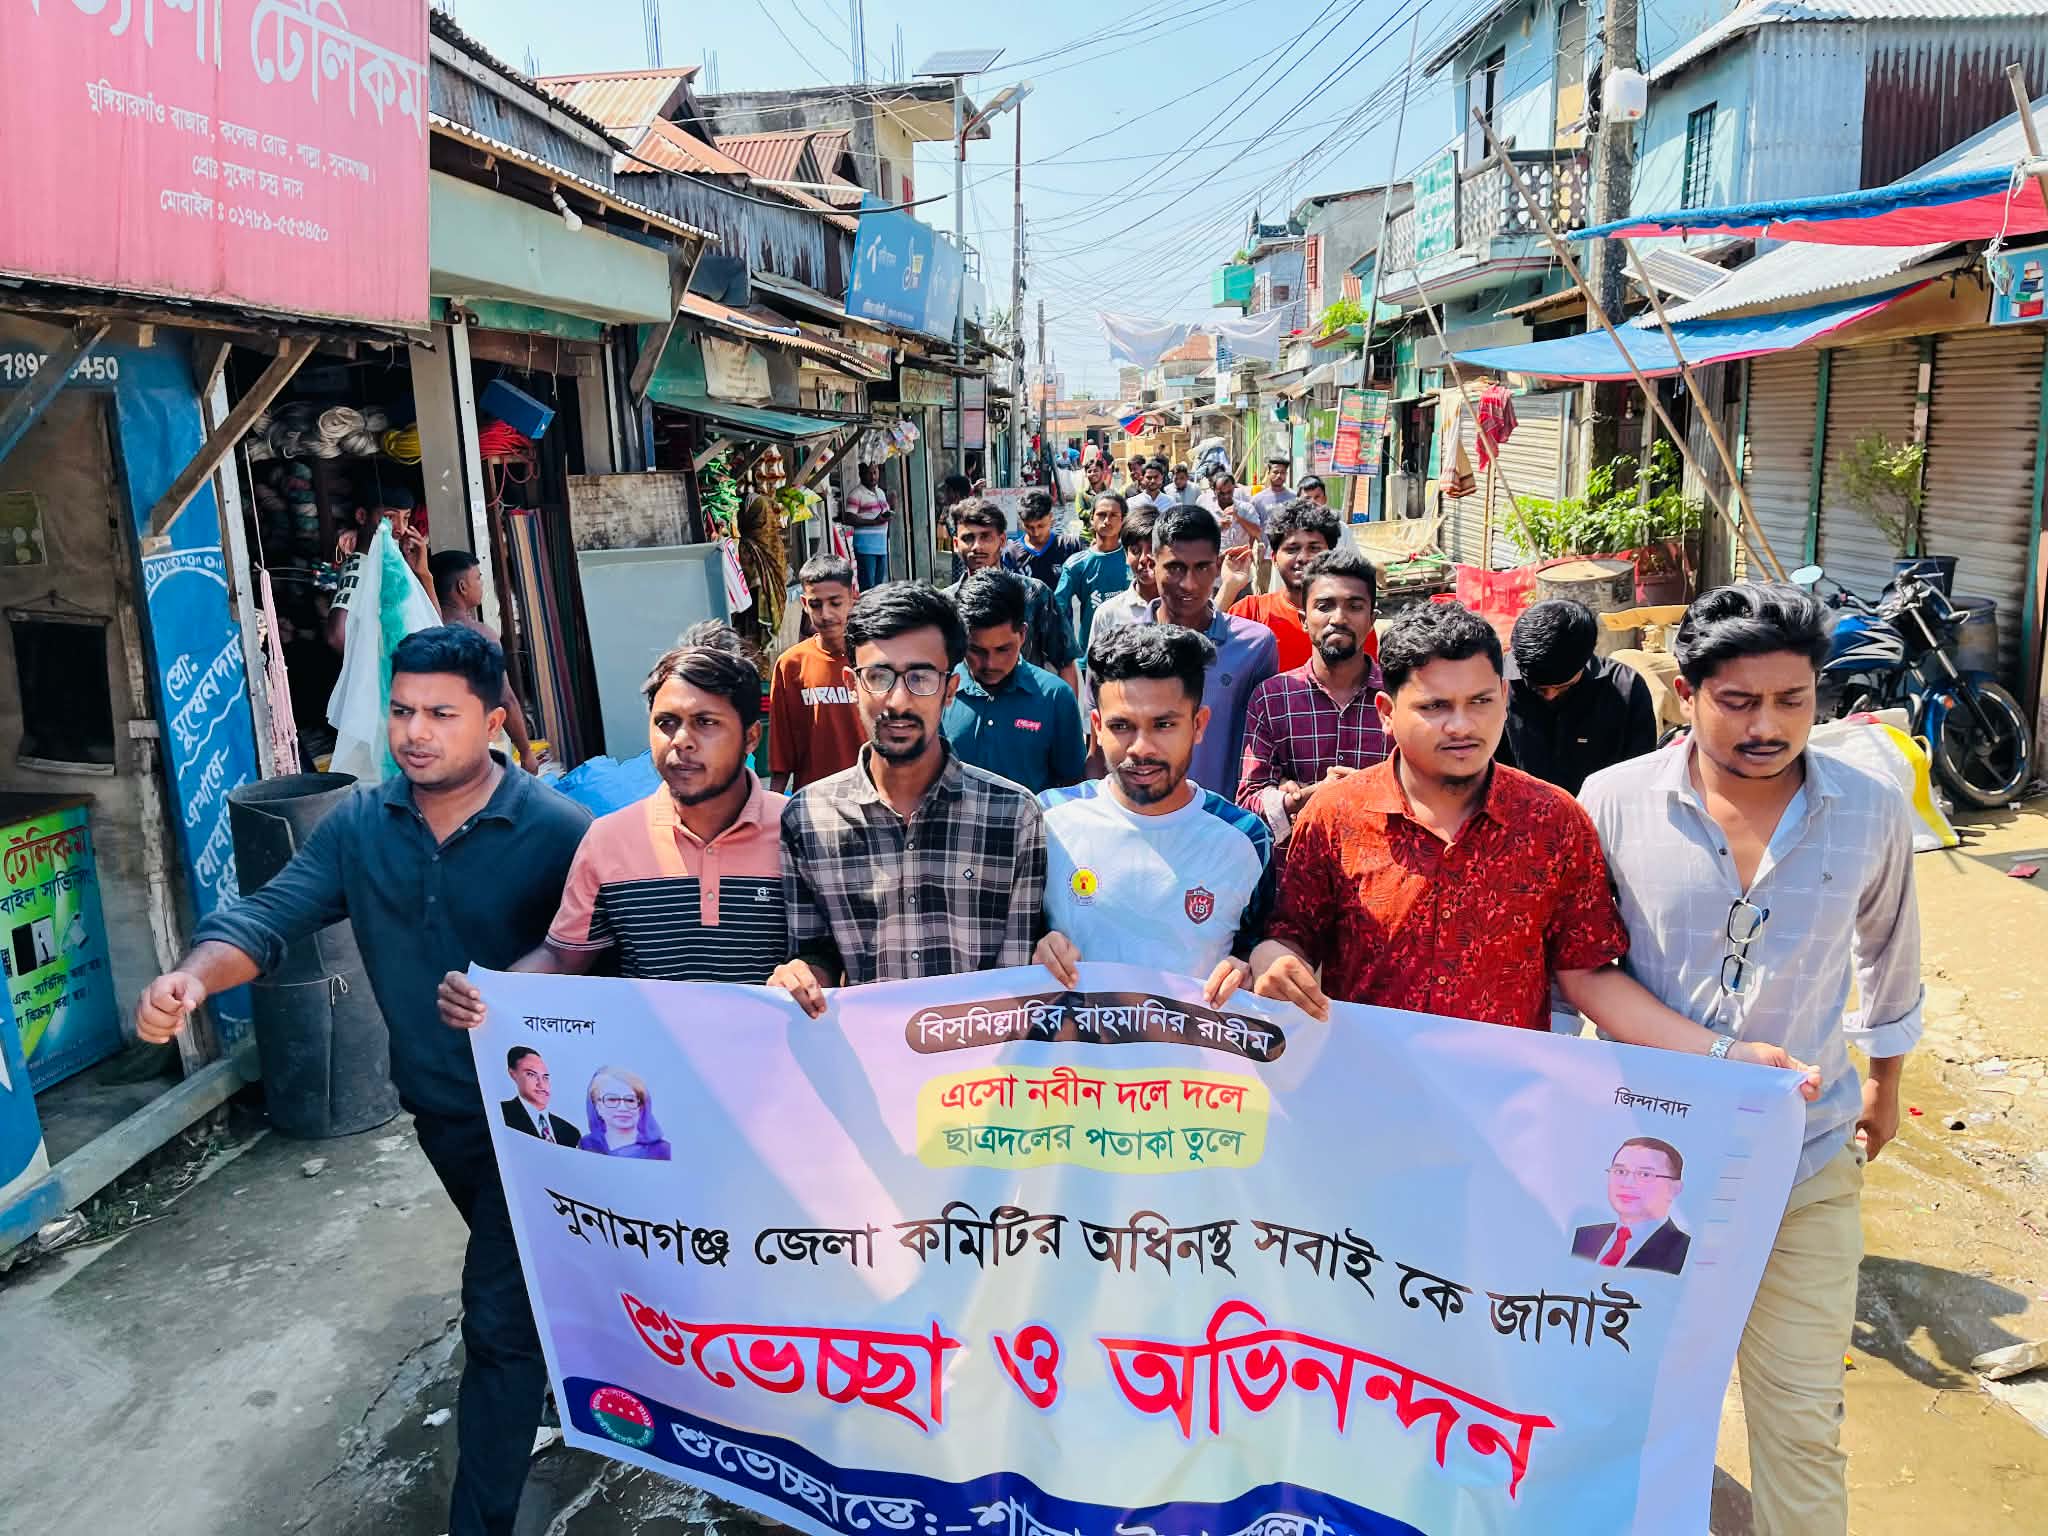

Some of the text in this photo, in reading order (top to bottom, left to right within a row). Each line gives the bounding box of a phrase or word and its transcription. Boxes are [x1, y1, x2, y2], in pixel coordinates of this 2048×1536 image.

[219, 119, 260, 151] কলেজ
[160, 188, 214, 220] মোবাইল
[282, 175, 304, 200] দাস
[2, 825, 89, 885] টেলিকম
[523, 1014, 596, 1037] বাংলাদেশ
[1072, 998, 1188, 1036] রাহমানির
[1196, 1014, 1274, 1056] রাহীম
[941, 1066, 1249, 1114] এসো নবীন দলে দলে
[1613, 1088, 1691, 1120] জিন্দাবাদ
[941, 1122, 1247, 1163] ছাত্রদলের পতাকা তুলে
[545, 1187, 1642, 1352] সুনামগঞ্জ জেলা কমিটির অধিনস্থ সবাই কে জানাই
[619, 1290, 963, 1433] শুভেচ্ছা
[992, 1325, 1062, 1409] ও
[1100, 1300, 1557, 1498] অভিনন্দন
